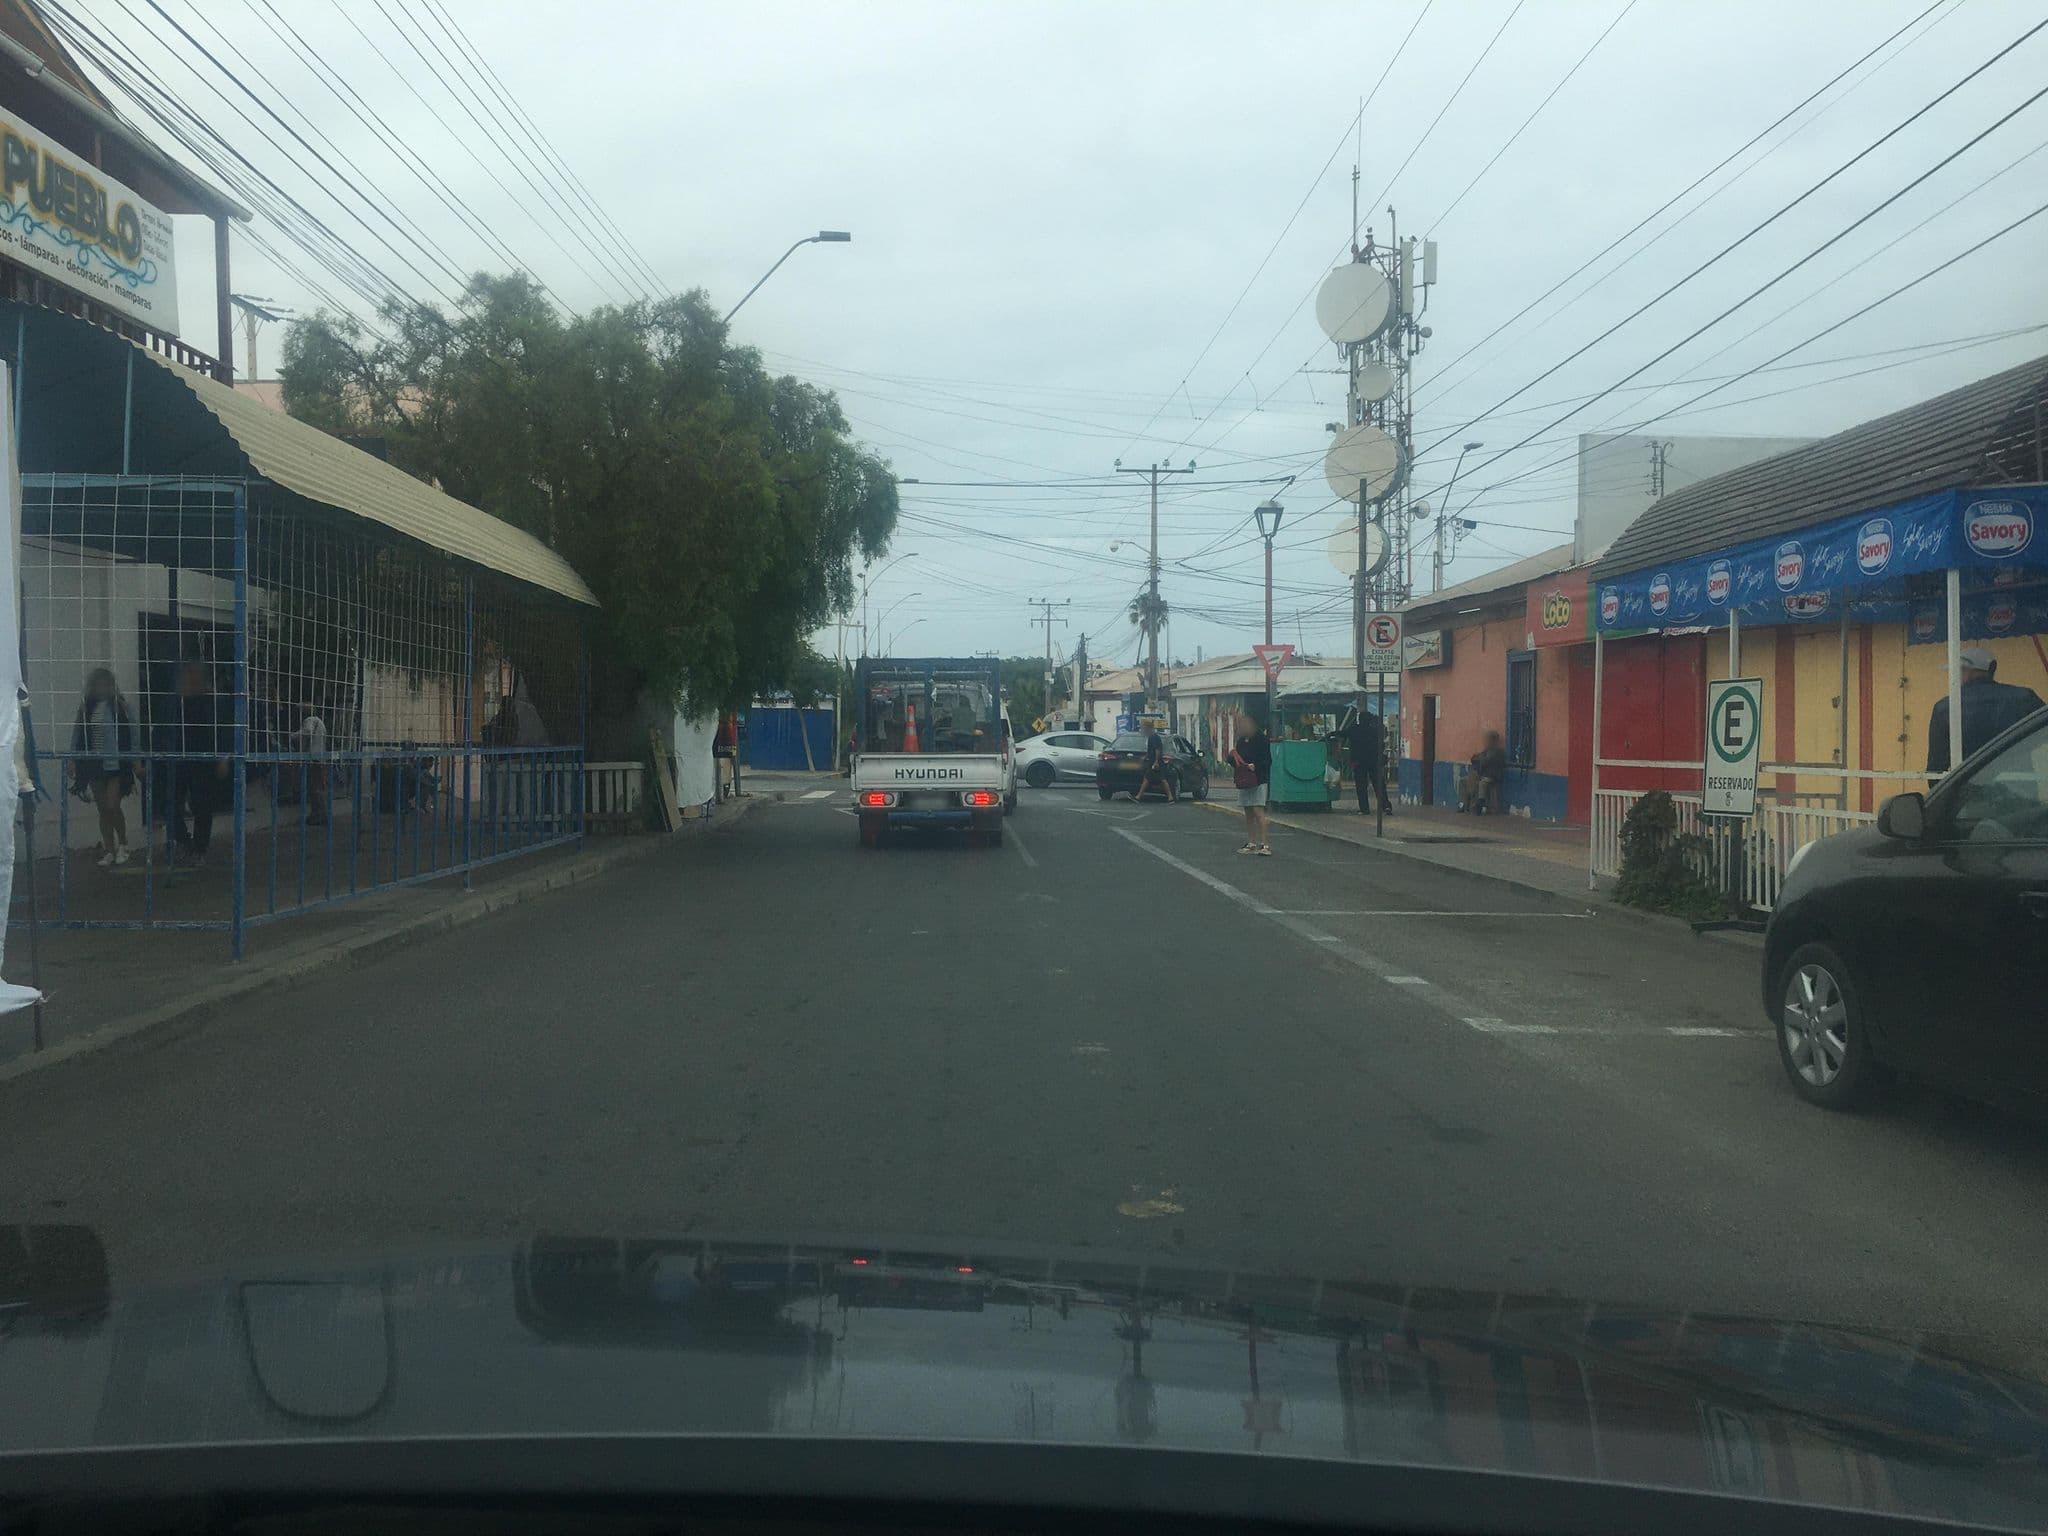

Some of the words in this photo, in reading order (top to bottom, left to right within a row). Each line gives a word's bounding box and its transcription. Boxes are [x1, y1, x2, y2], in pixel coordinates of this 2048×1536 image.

[3, 132, 142, 261] PUEBLO
[20, 235, 59, 266] lámparas
[66, 258, 109, 289] decoración
[115, 284, 152, 310] mamparas
[1971, 523, 2026, 541] Savory
[1860, 542, 1889, 560] Savory
[1777, 562, 1801, 578] Savory
[1376, 621, 1390, 643] E
[1724, 701, 1744, 746] E
[895, 768, 963, 779] HYUNDAI
[1708, 777, 1753, 791] RESERVADO
